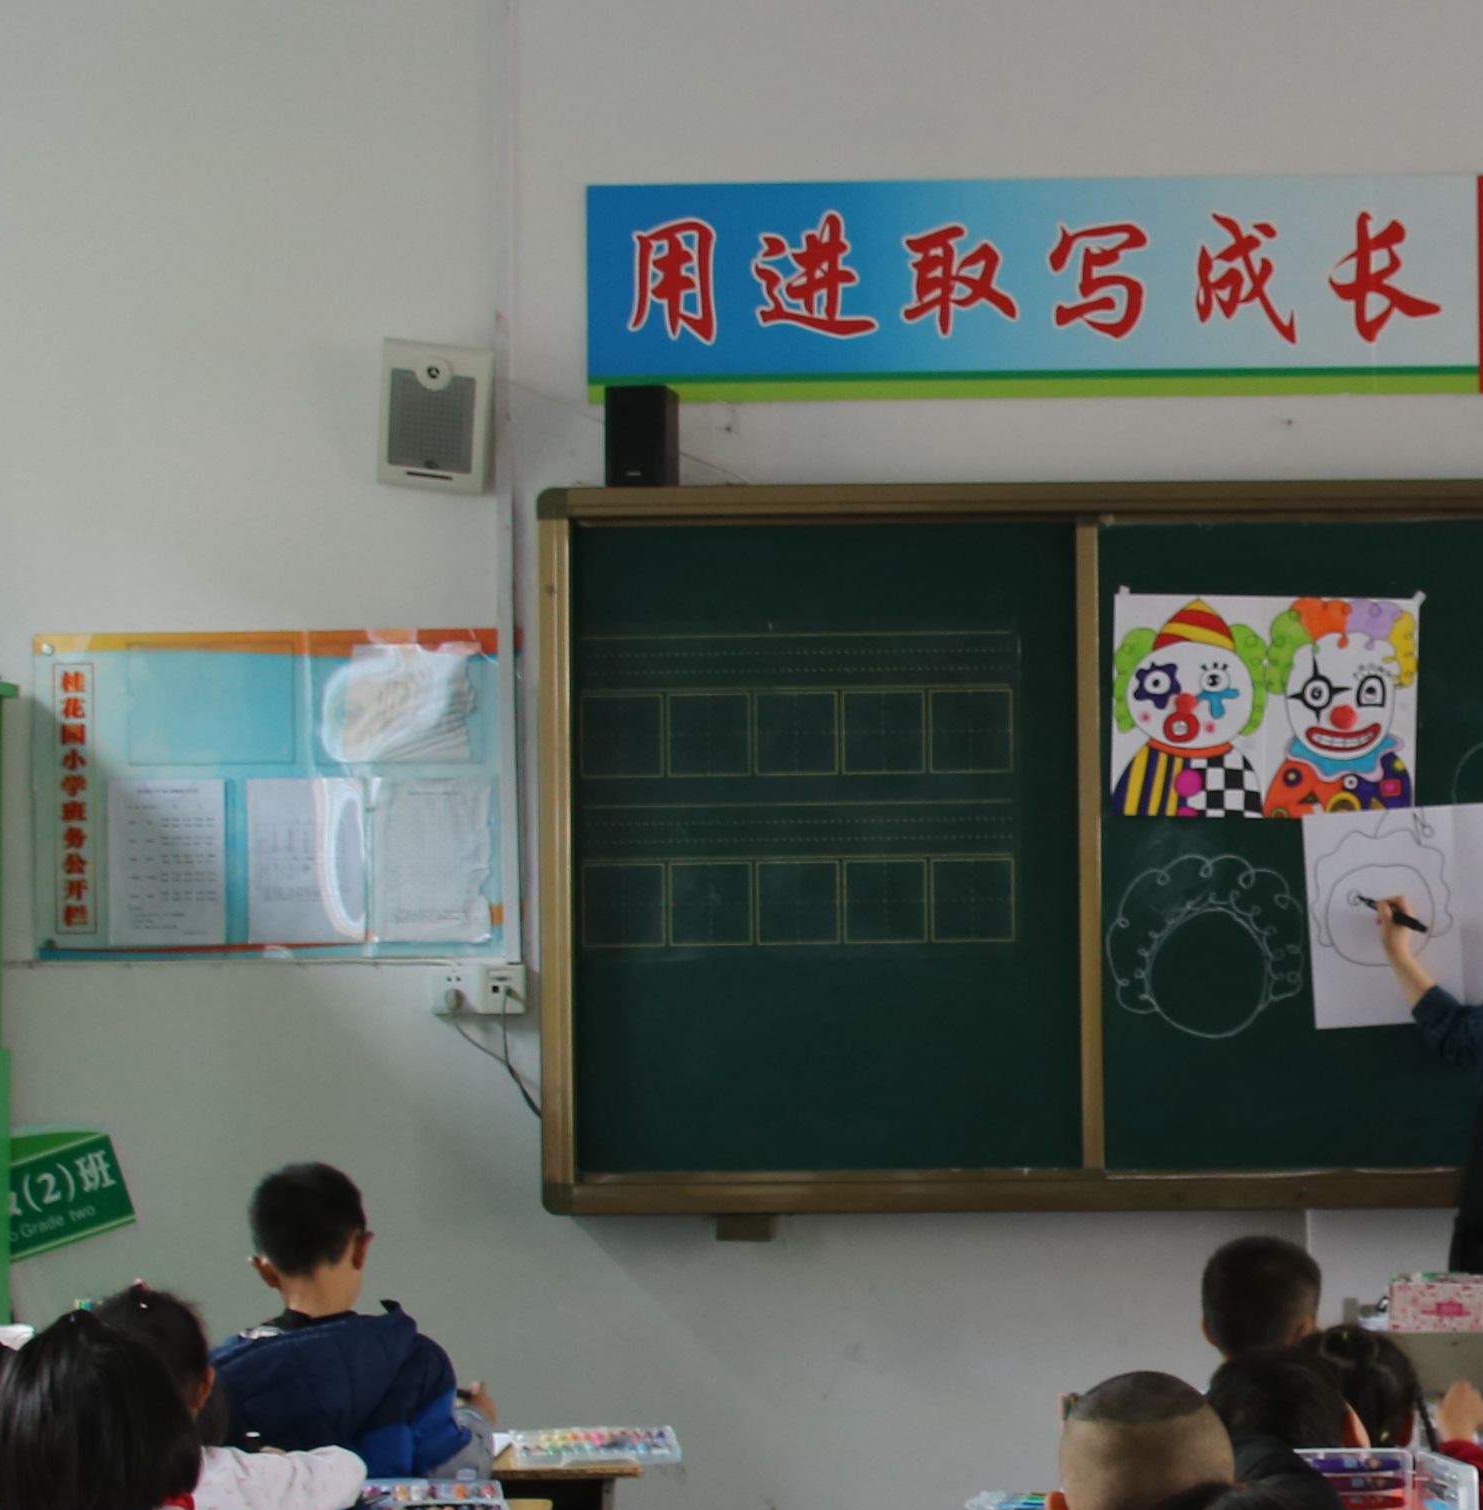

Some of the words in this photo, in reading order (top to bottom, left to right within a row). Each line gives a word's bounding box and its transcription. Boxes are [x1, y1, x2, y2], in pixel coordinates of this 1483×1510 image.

[629, 209, 1443, 345] 用进取写成长
